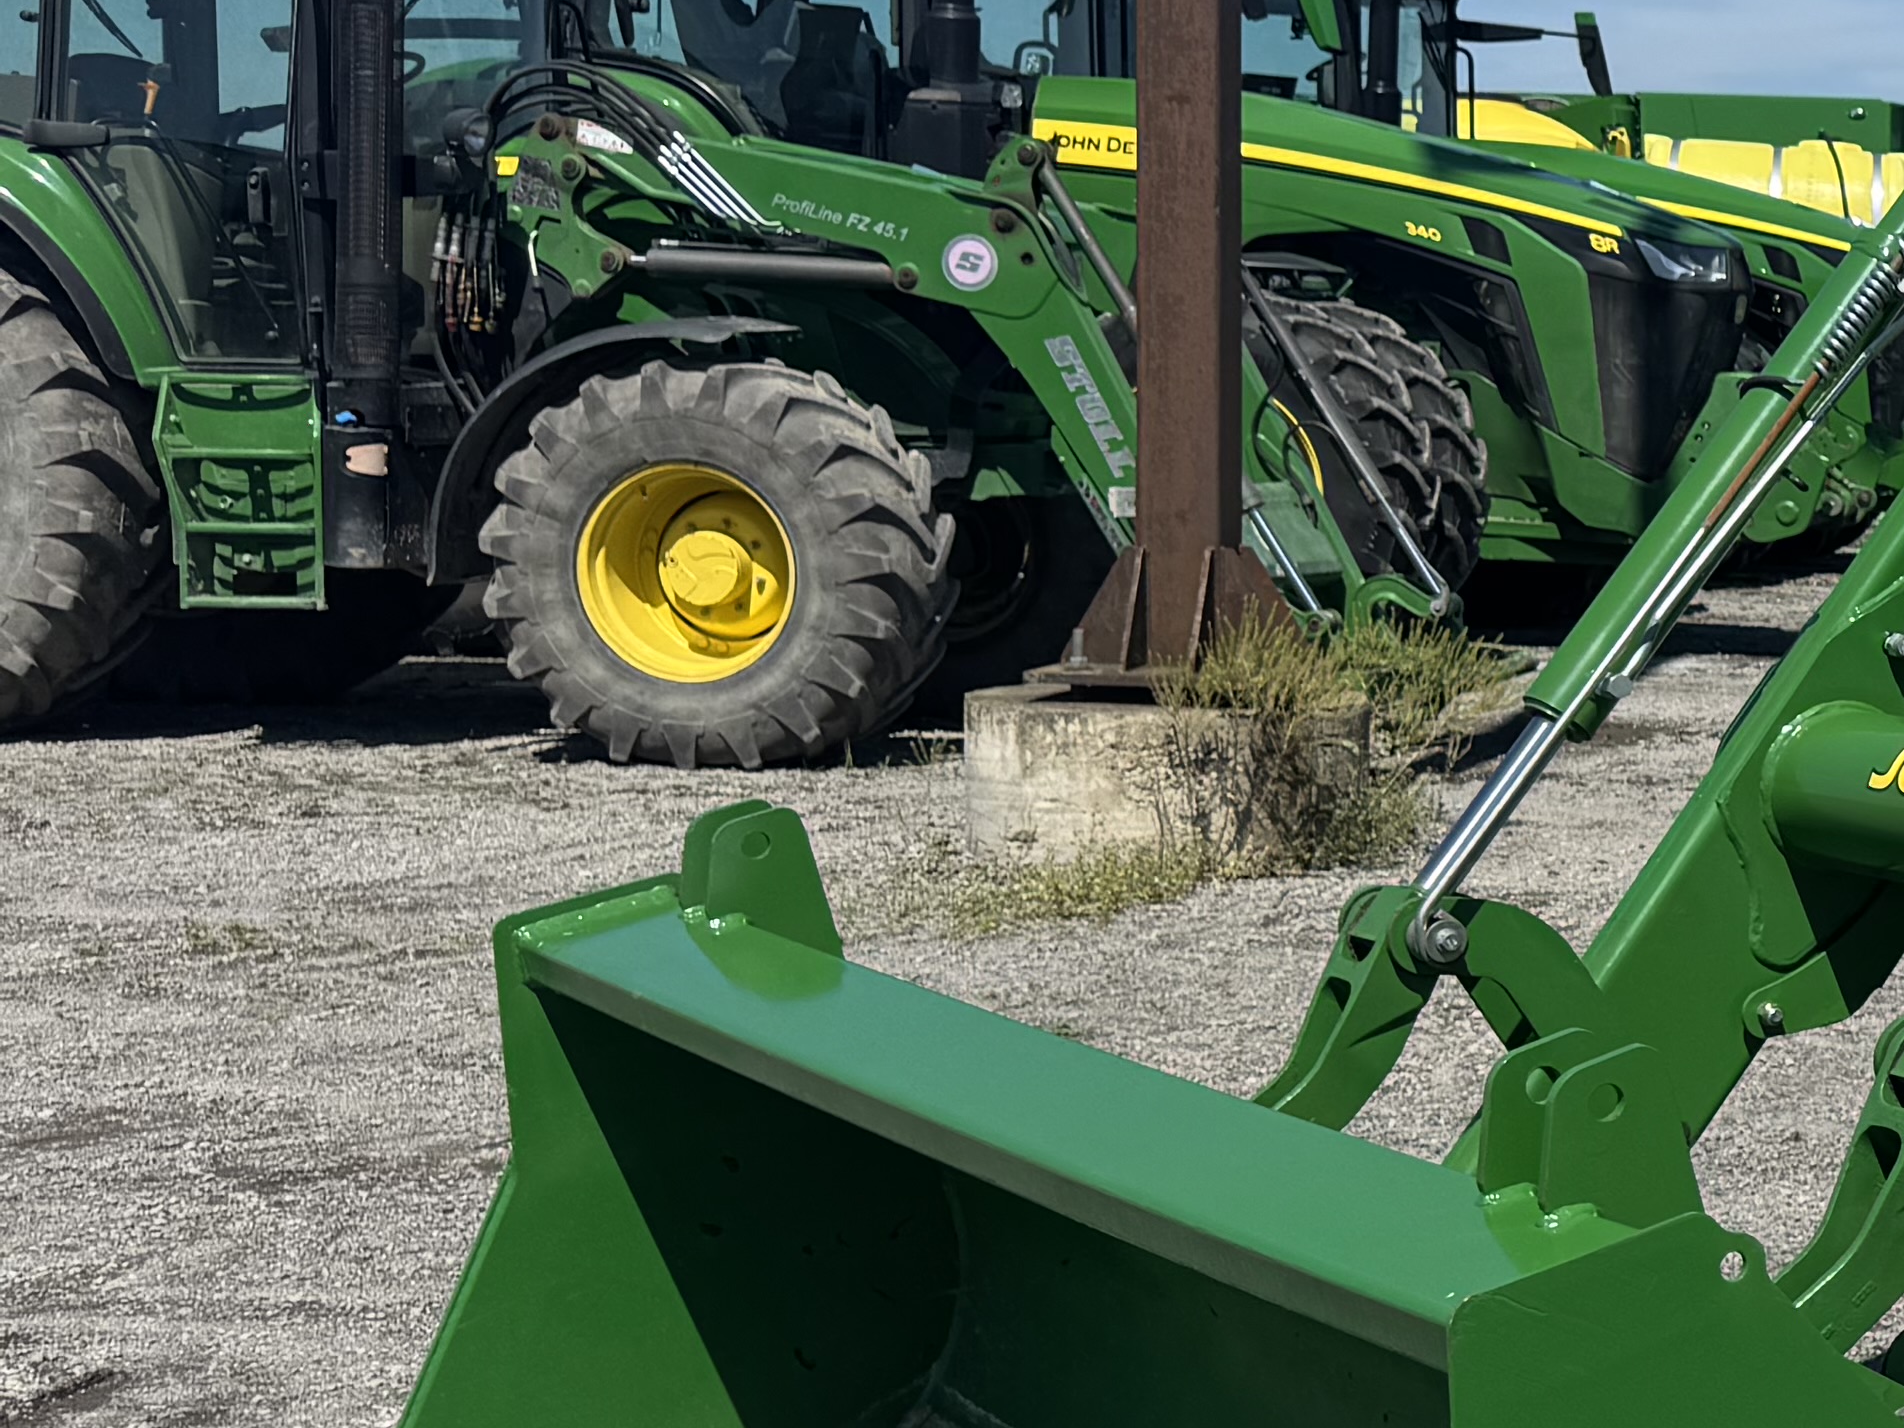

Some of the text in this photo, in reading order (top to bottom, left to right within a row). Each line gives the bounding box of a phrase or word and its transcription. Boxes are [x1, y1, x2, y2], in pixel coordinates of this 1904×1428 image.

[1047, 131, 1101, 151] JOHN
[771, 193, 909, 241] ProfiLine FZ 45.1
[1405, 221, 1441, 242] 340
[1589, 233, 1620, 254] 8R
[1044, 335, 1137, 478] STOLL
